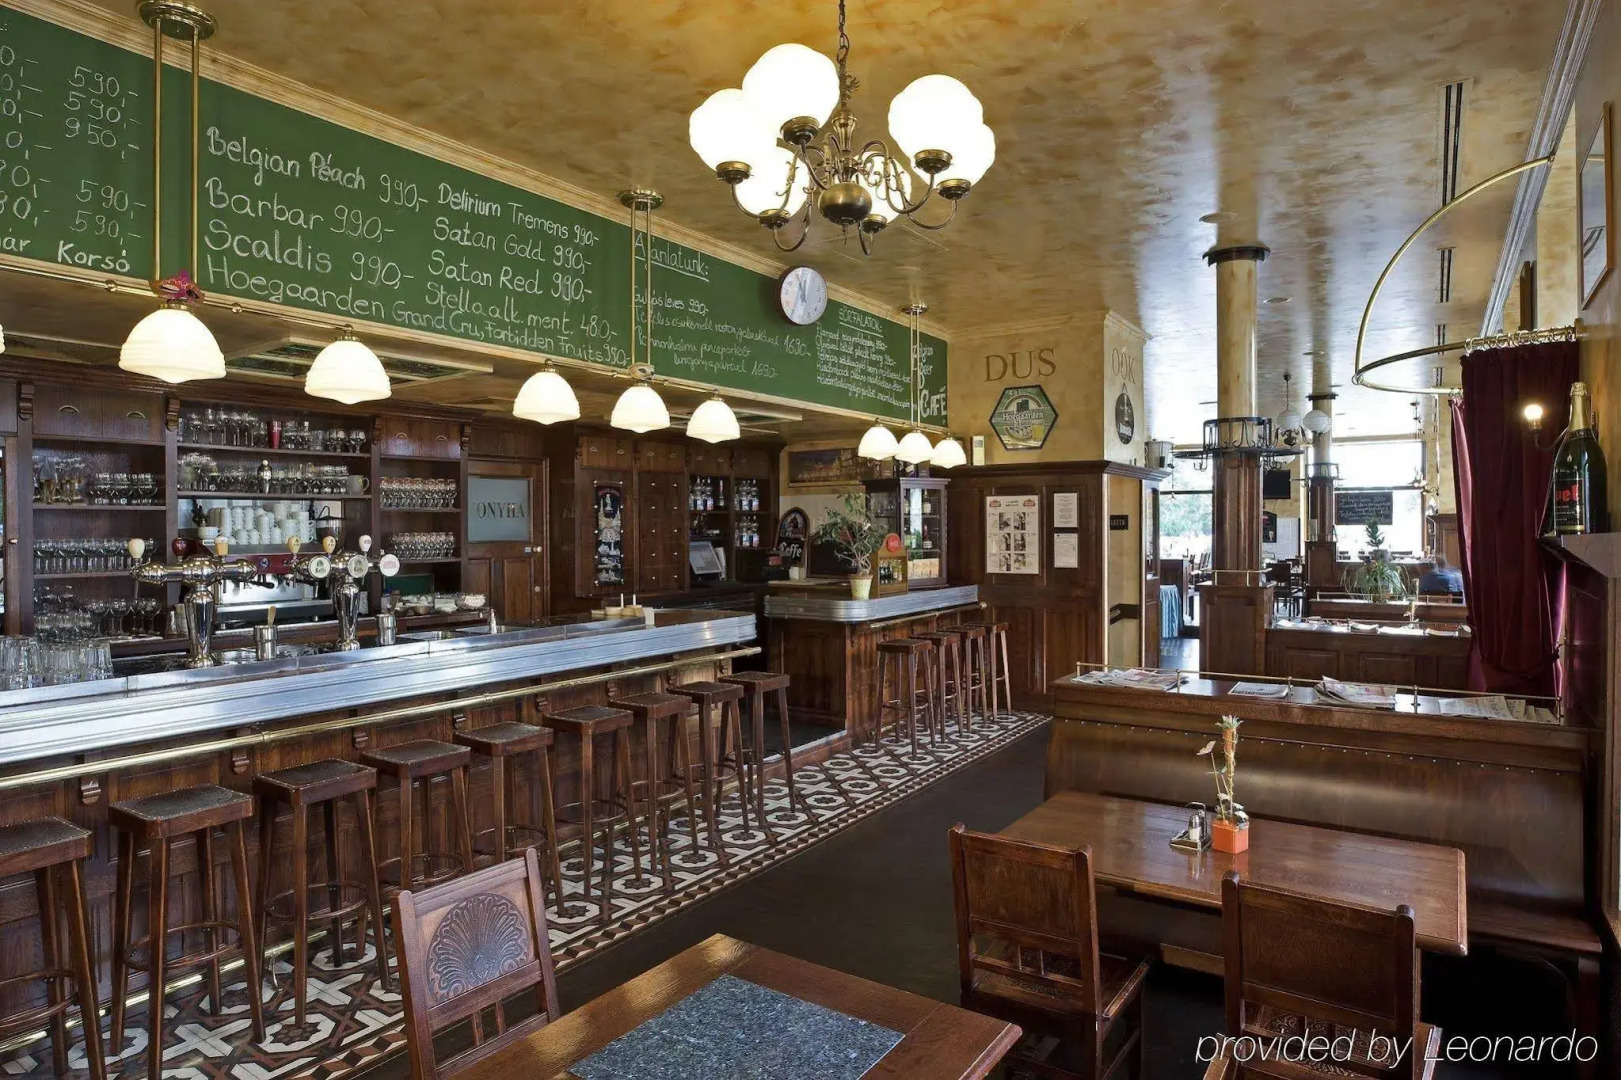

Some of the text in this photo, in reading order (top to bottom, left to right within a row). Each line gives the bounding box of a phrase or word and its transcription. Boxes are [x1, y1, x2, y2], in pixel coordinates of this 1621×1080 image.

[207, 126, 300, 187] Belgian
[379, 173, 428, 213] 990,-
[205, 177, 395, 243] Barbar 990,-
[438, 182, 600, 247] Delirium Tremens 990,-
[57, 239, 131, 273] Korsó
[204, 219, 415, 290] Scaldis 990,-
[433, 216, 592, 275] Satan Gold 990,-
[634, 232, 710, 276] Aánlatunk:
[428, 249, 593, 303] Satan Red 990,-
[207, 253, 384, 320] Hoegaarden
[392, 300, 447, 331] Grand
[484, 320, 554, 351] Forbidden
[557, 335, 603, 362] Fruits
[425, 281, 487, 317] Stella
[527, 311, 574, 335] ment.
[580, 314, 618, 342] 480,-
[984, 347, 1057, 383] DUS
[1112, 347, 1136, 385] OOK
